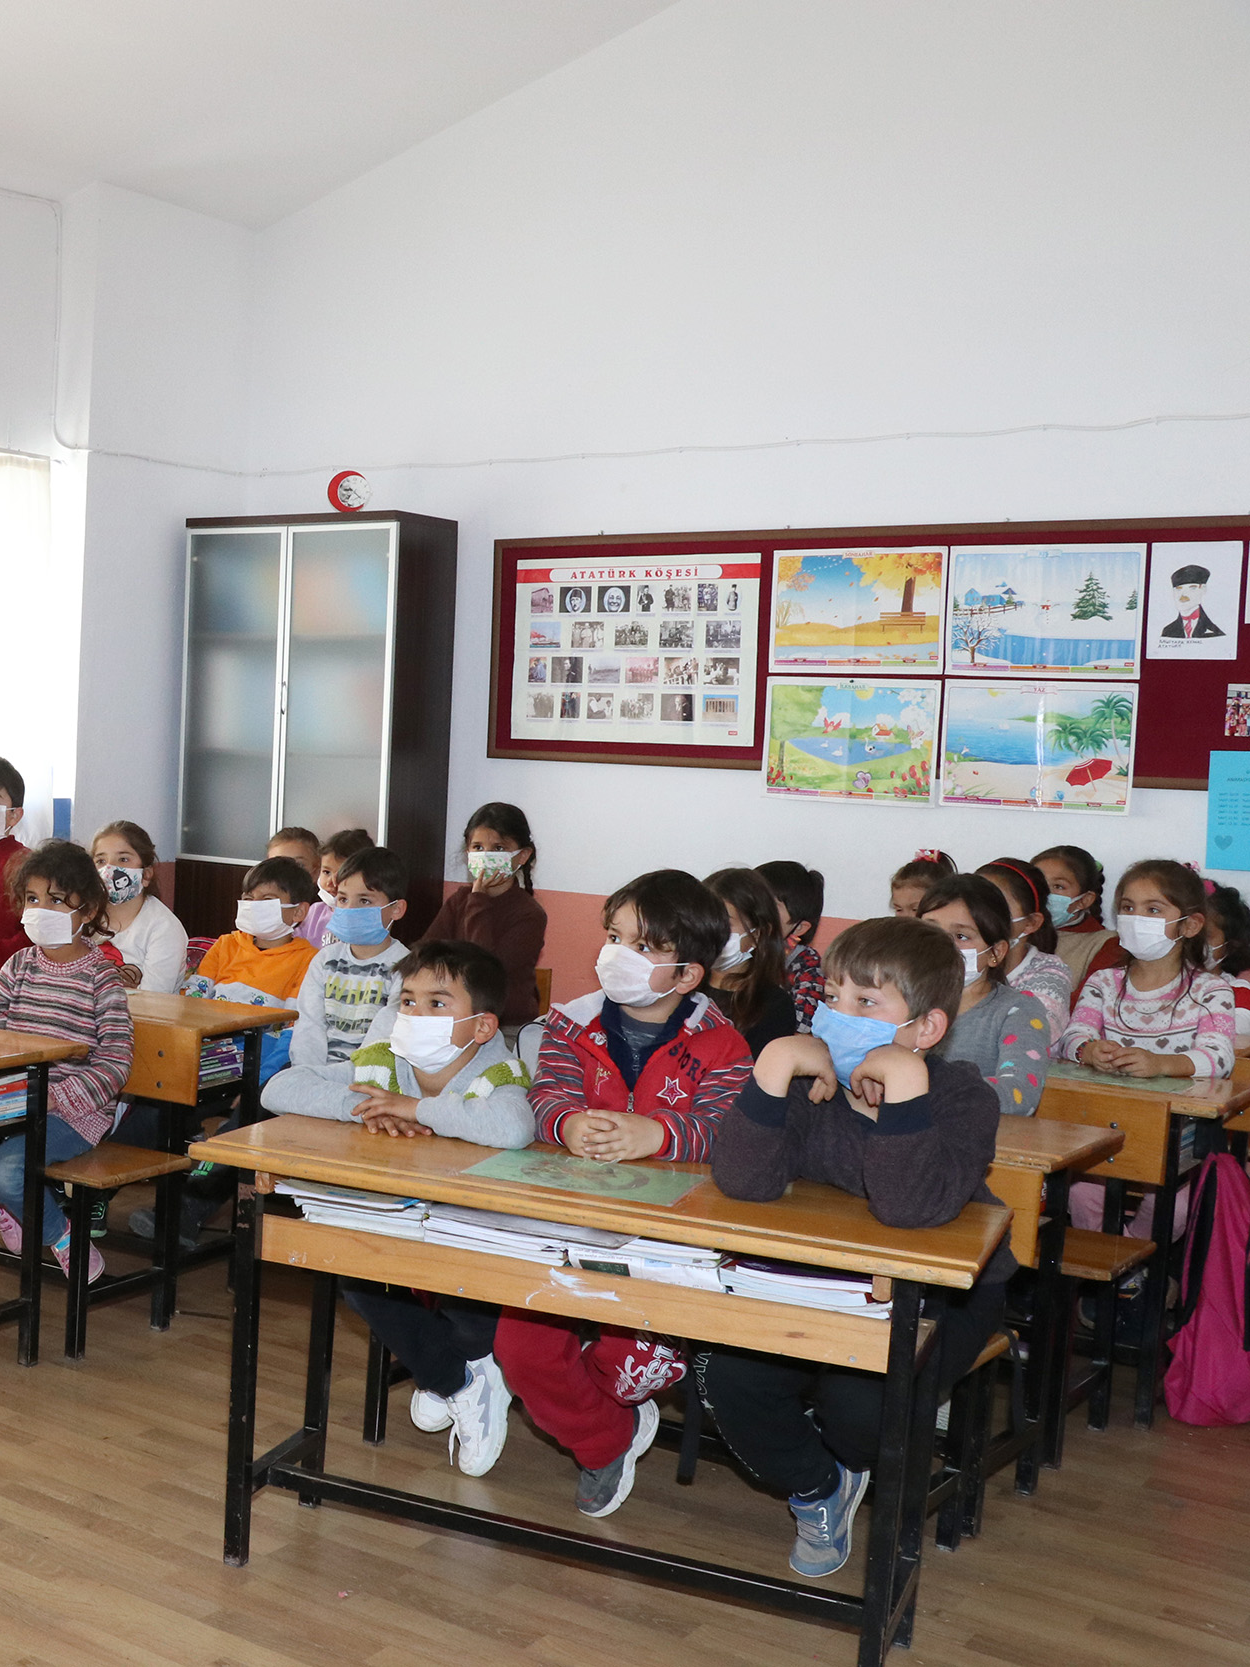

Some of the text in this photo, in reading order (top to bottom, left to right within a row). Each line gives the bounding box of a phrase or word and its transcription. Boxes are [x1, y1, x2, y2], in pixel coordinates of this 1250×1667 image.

[570, 566, 700, 580] ATATÜRK KÖŞESİ
[325, 975, 384, 1005] WHAT
